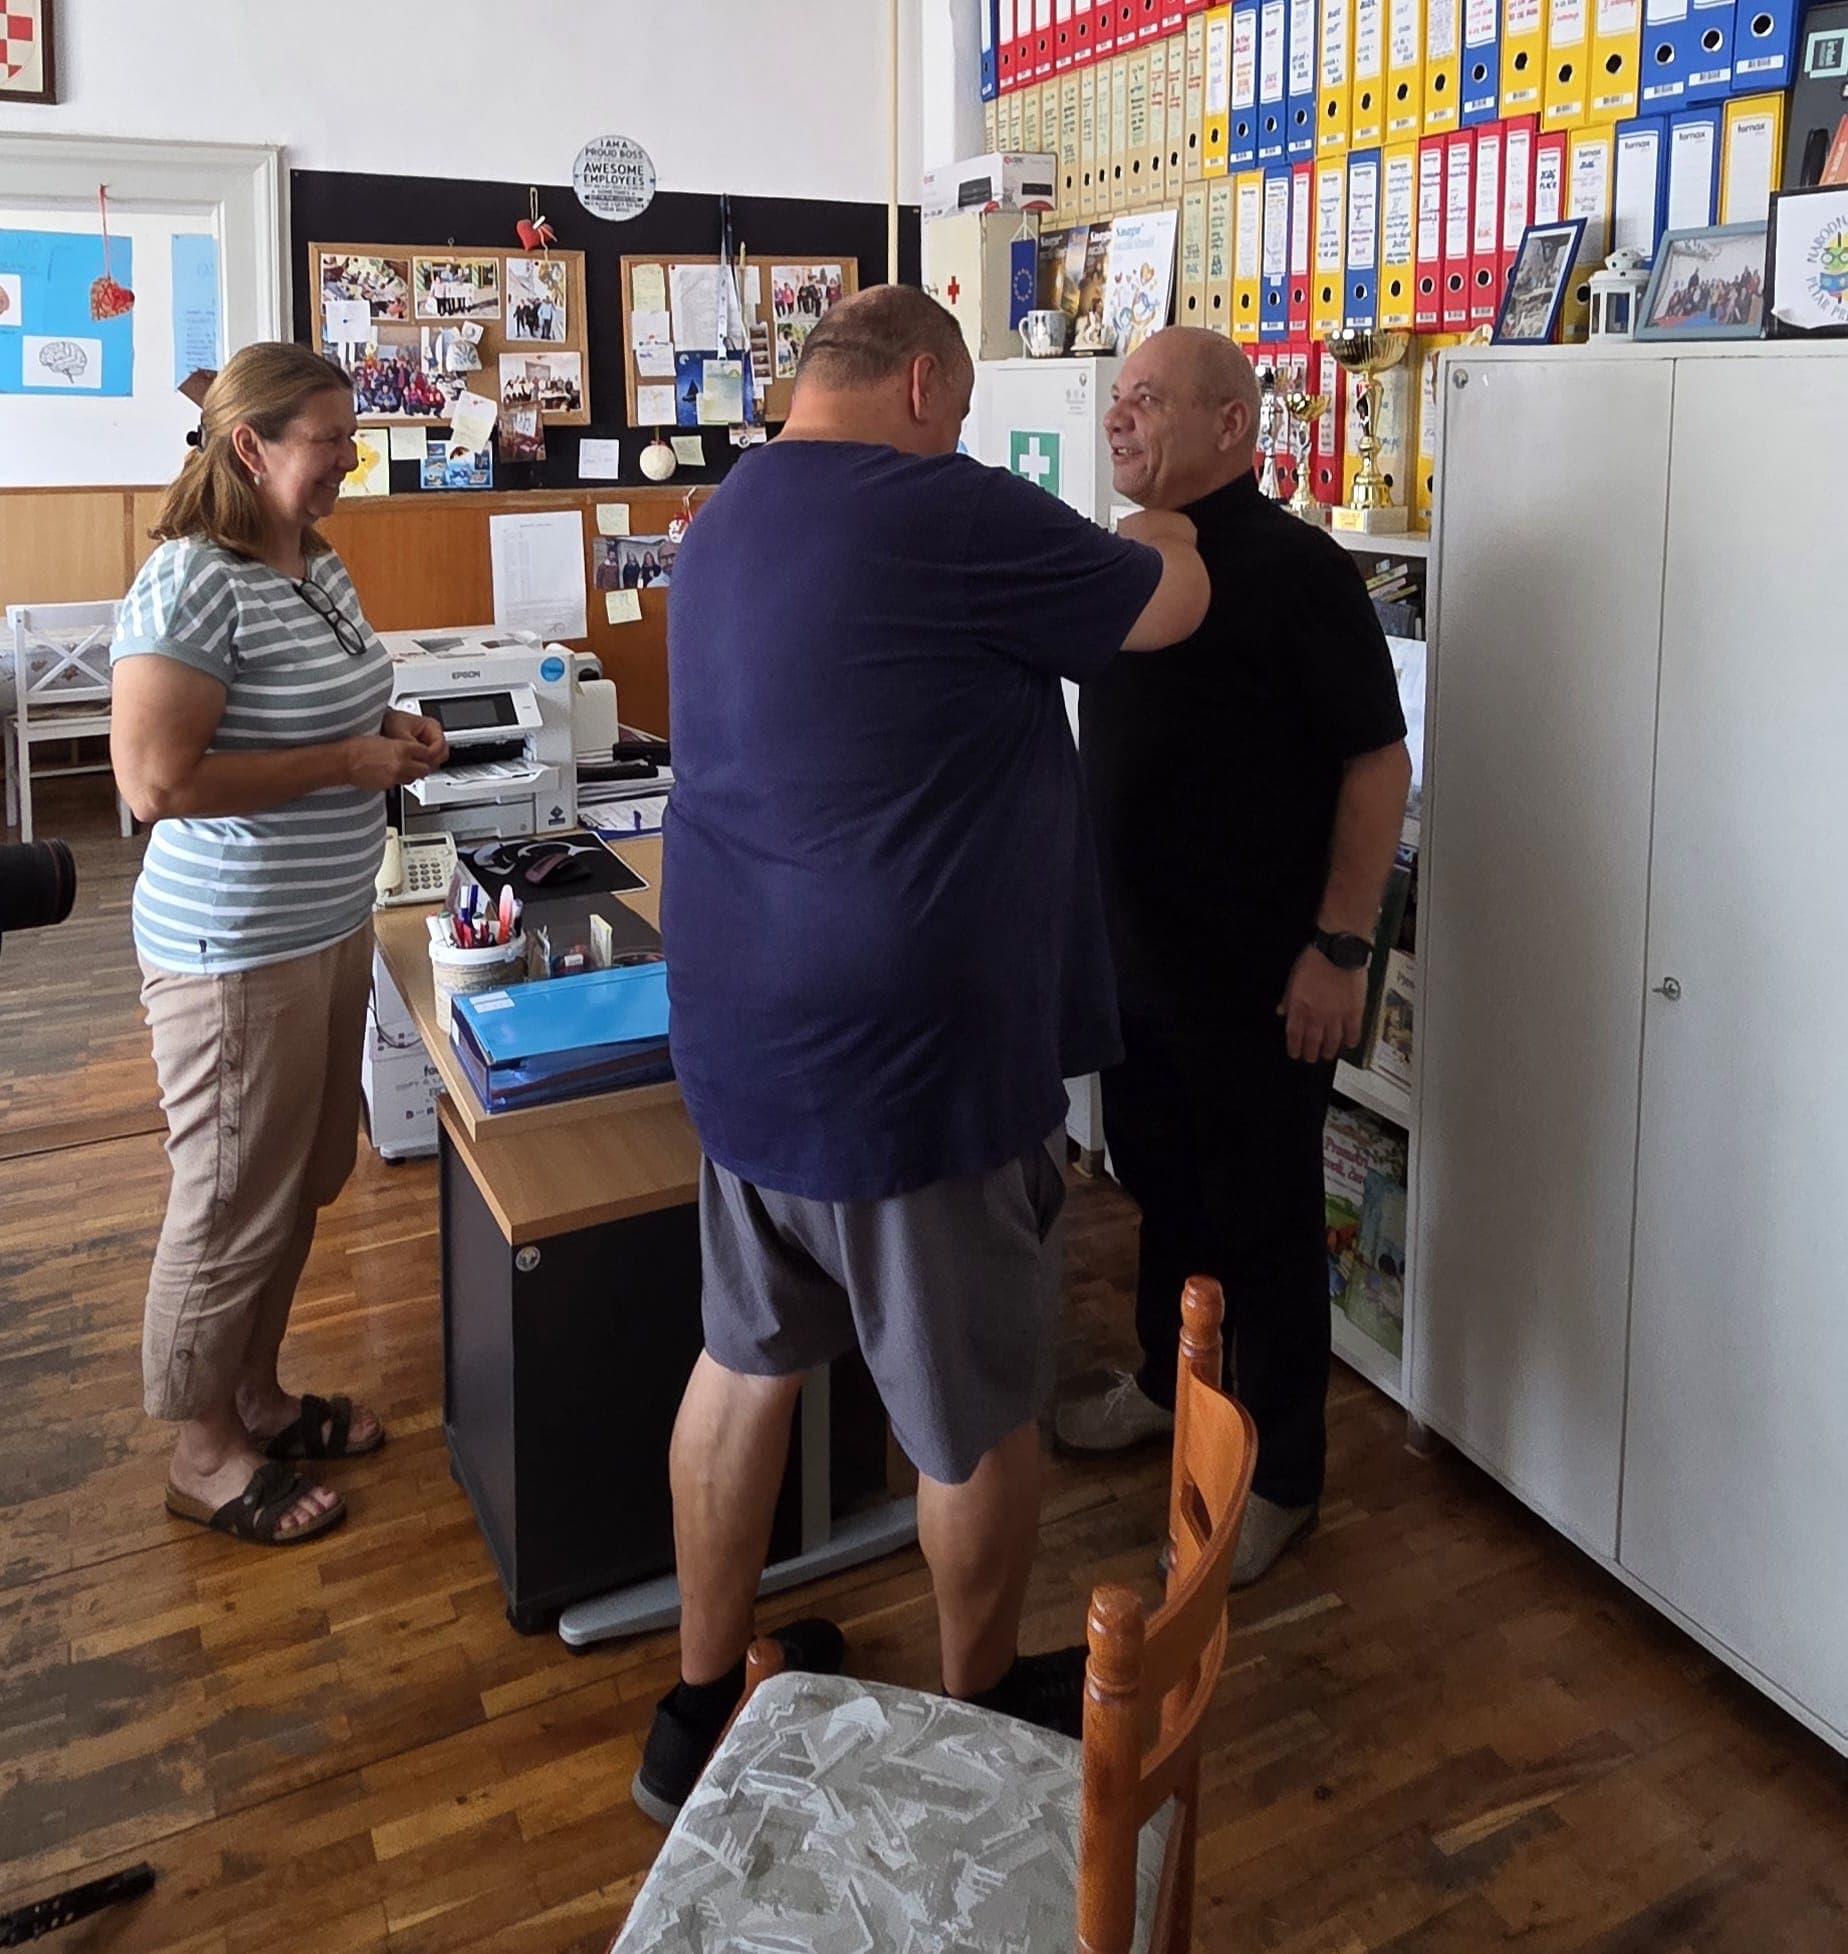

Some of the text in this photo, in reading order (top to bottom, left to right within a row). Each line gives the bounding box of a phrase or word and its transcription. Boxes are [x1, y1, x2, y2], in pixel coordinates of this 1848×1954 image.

[600, 139, 628, 149] I AM A
[585, 147, 643, 160] PROUD BOSS
[584, 162, 643, 176] AWESOME
[584, 174, 644, 185] EMPLOYEES
[452, 670, 481, 680] EPSON
